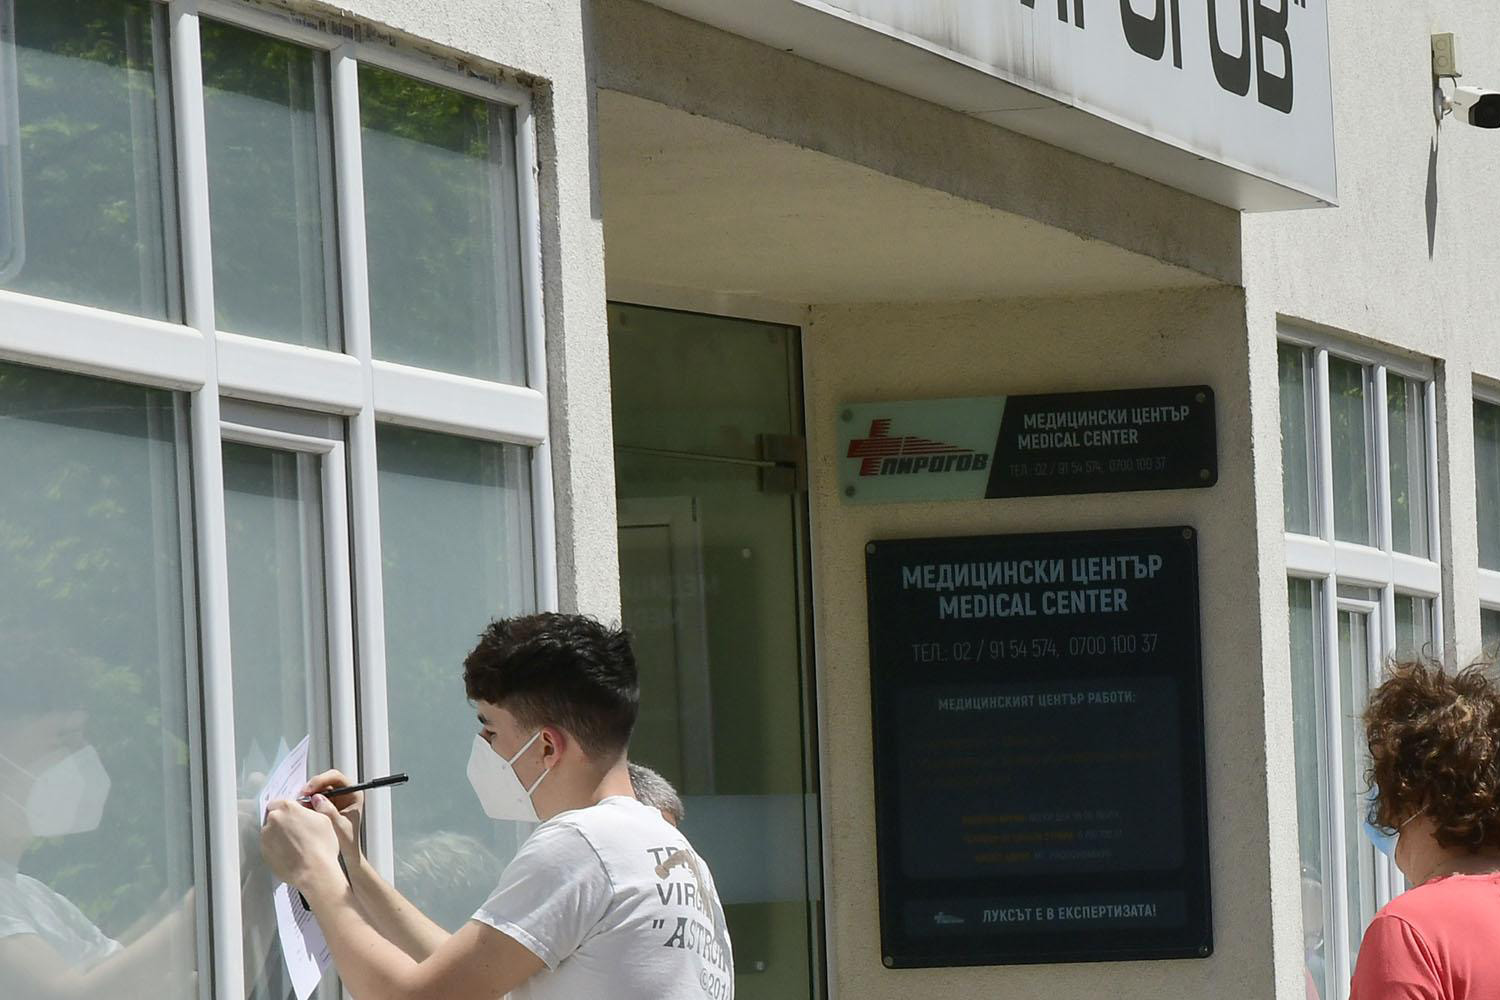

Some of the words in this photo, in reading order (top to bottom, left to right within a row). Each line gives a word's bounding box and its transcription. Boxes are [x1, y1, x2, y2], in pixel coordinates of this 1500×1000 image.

[1024, 409, 1128, 430] МЕДИЦИНСКИ
[1132, 406, 1190, 424] ЦЕНТЪР
[1017, 431, 1080, 450] MEDICAL
[1084, 429, 1138, 447] CENTER
[880, 453, 989, 476] ПИРОГОВ
[902, 559, 1065, 591] МЕДИЦИНСКИ
[1071, 554, 1163, 584] ЦЕНТЪР
[939, 591, 1036, 620] MEDICAL
[1041, 588, 1129, 616] CENTER
[953, 641, 971, 661] 02
[990, 640, 1005, 660] 91
[1009, 639, 1028, 659] 54
[1069, 636, 1105, 657] 0700
[1111, 634, 1136, 655] 100
[1141, 633, 1158, 653] 37
[938, 694, 1035, 712] МЕДИЦИНСКИЯТ
[1038, 693, 1085, 708] ЦЕНТЪР
[1088, 691, 1136, 706] РАБОТИ:
[983, 906, 1033, 924] ЛУКСЪТ
[1036, 907, 1044, 921] Е
[1047, 906, 1055, 920] В
[1059, 903, 1157, 920] ЕКСПЕРТИЗАТА!
